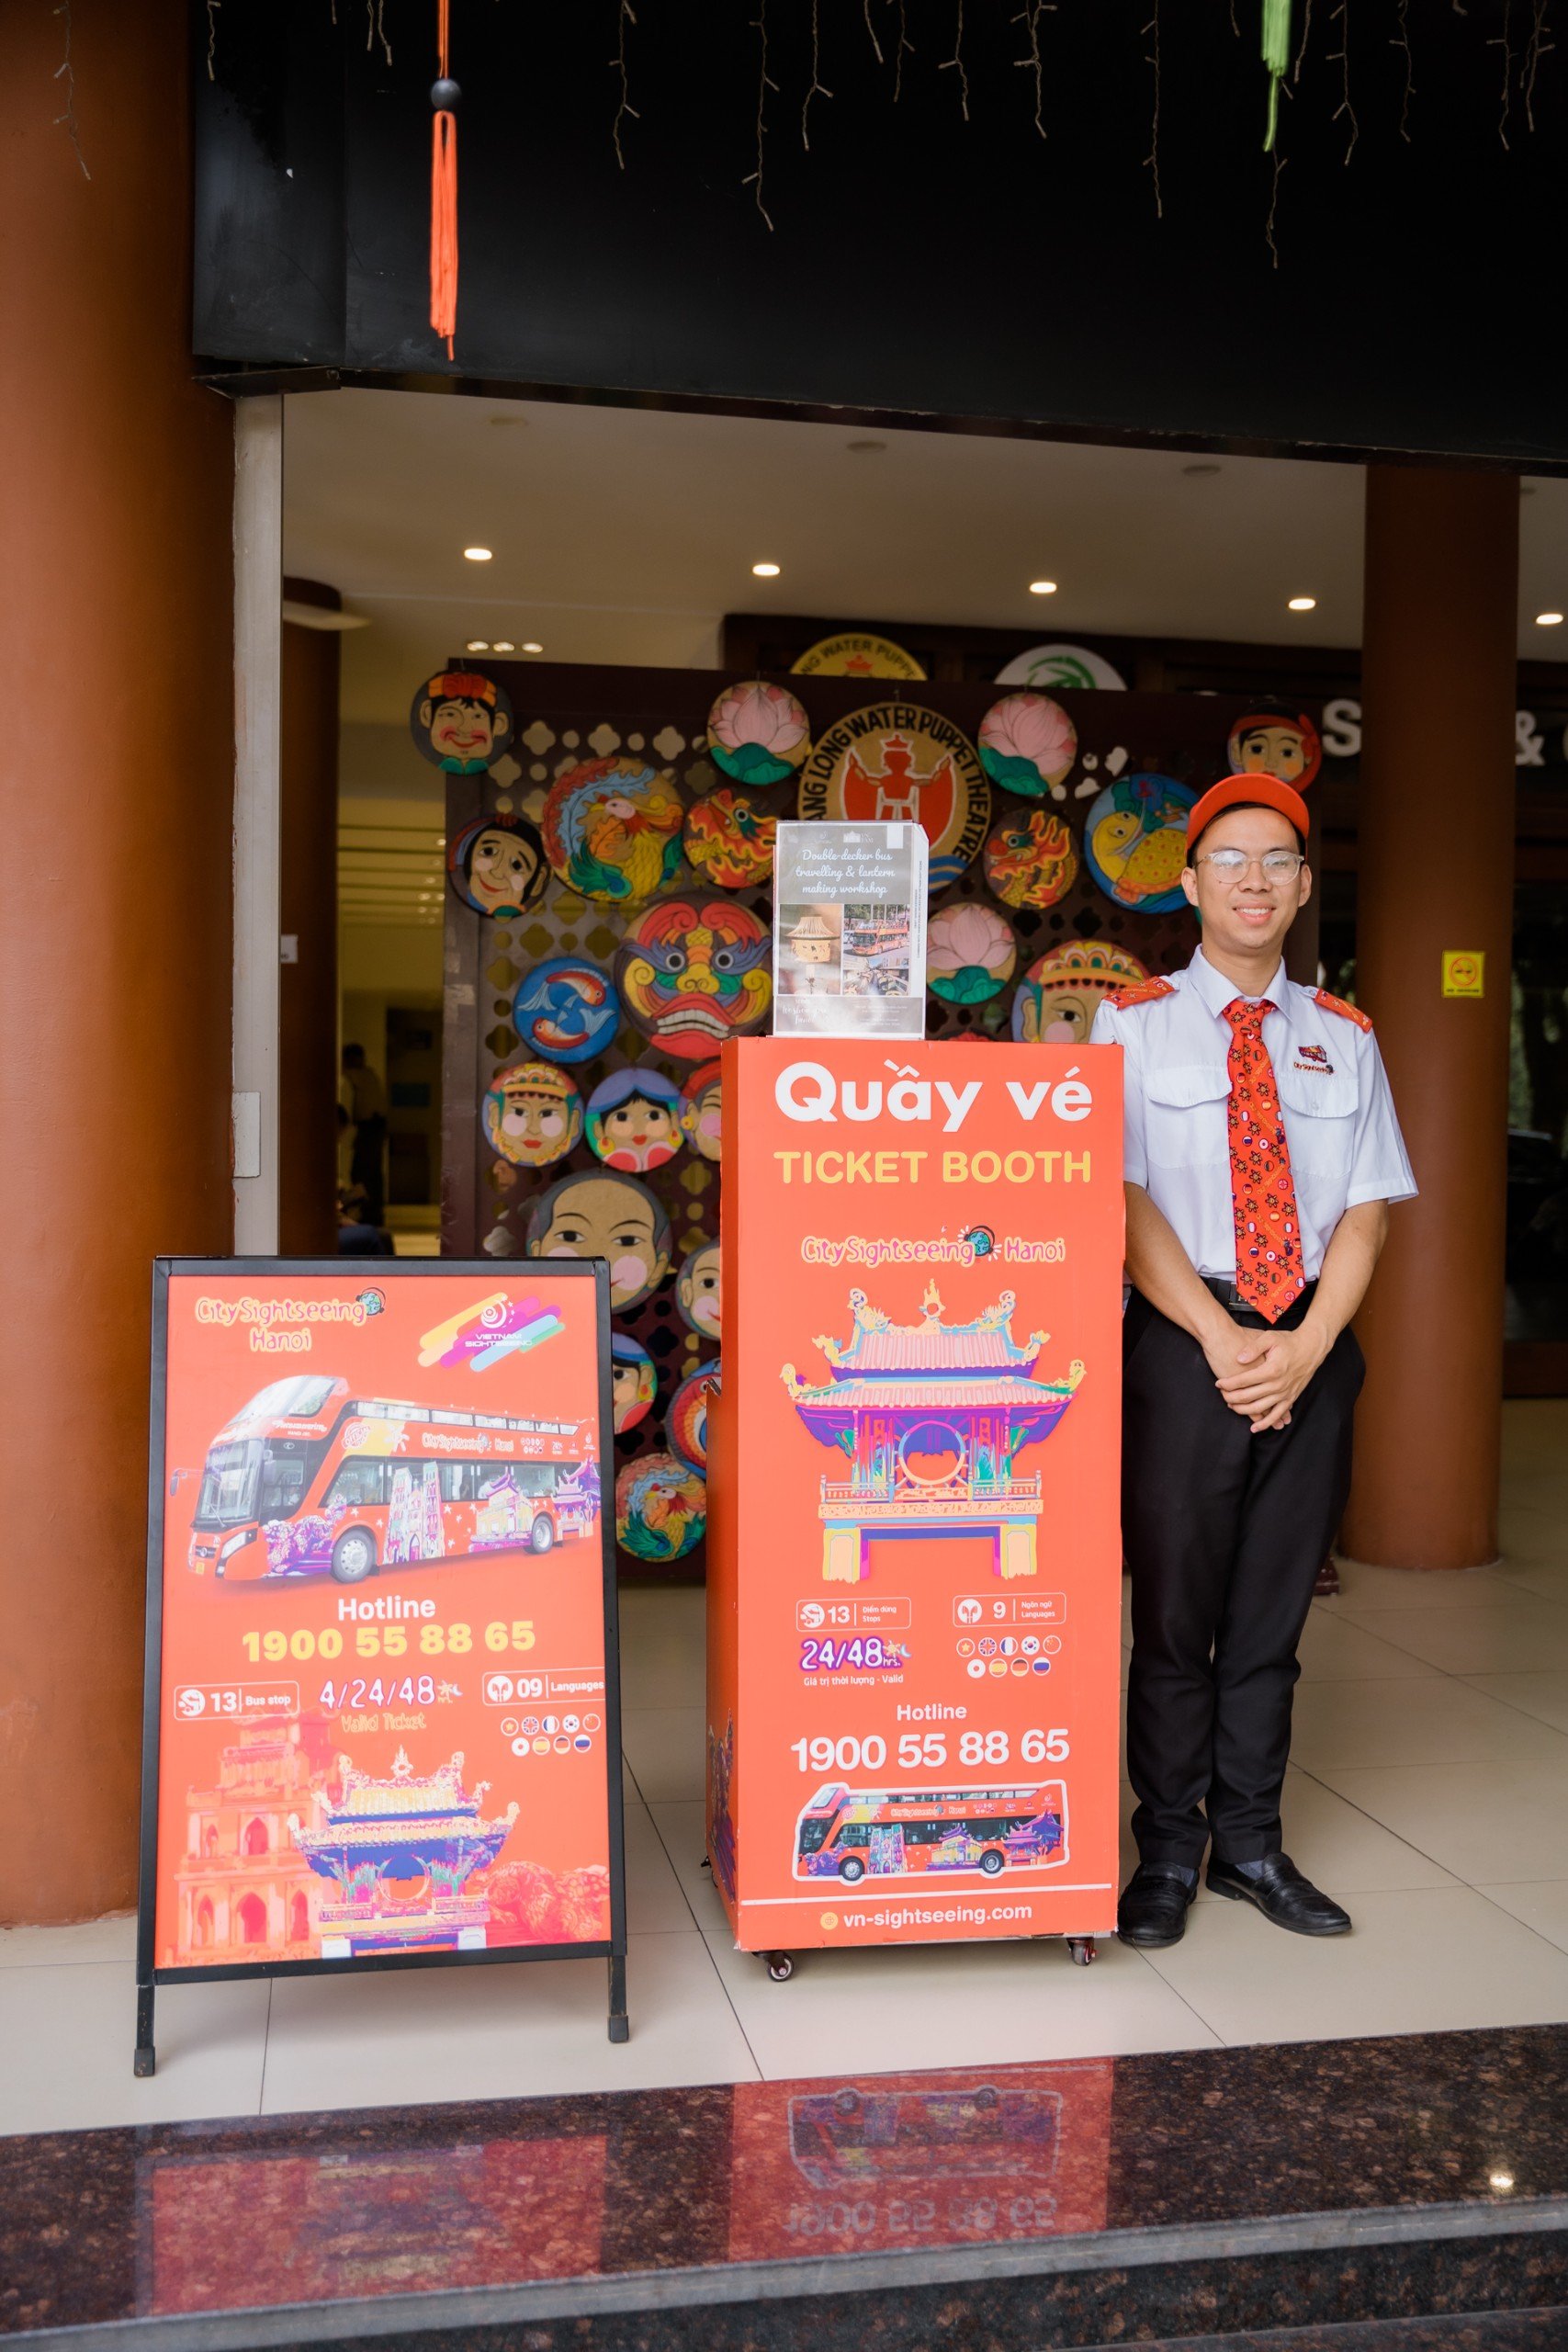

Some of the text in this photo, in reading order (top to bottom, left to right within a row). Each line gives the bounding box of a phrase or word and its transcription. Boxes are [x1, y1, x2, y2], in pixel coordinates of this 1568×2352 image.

[820, 639, 873, 659] WATER
[808, 728, 852, 781] LONG
[844, 707, 918, 739] WATER
[919, 713, 974, 772] PUPPET
[953, 771, 989, 862] THEATRE
[801, 848, 893, 861] Double-decker bus
[795, 865, 896, 881] travelling & lantern
[802, 881, 888, 899] making workshop
[774, 1058, 1093, 1132] Quầy vé
[773, 1150, 1091, 1184] TICKET BOOTH
[1004, 1237, 1066, 1263] Hanoi
[249, 1328, 311, 1353] Hanoi
[337, 1596, 435, 1622] Hotline
[827, 1605, 851, 1624] 13
[863, 1614, 881, 1623] Stops
[992, 1600, 1006, 1619] 9
[1021, 1610, 1055, 1619] Languages
[242, 1620, 536, 1663] 1900 55 88 65
[801, 1638, 884, 1670] 24/48
[517, 1678, 605, 1698] 09 Languages
[882, 1673, 904, 1684] Valid
[210, 1691, 291, 1713] 13 Bus stop
[320, 1675, 435, 1709] 4/24/48
[341, 1712, 427, 1734] Valid Ticket
[897, 1703, 967, 1721] Hotline
[791, 1728, 1070, 1772] 1900 55 88 65
[843, 1904, 1032, 1929] vn-sightseeing.com
